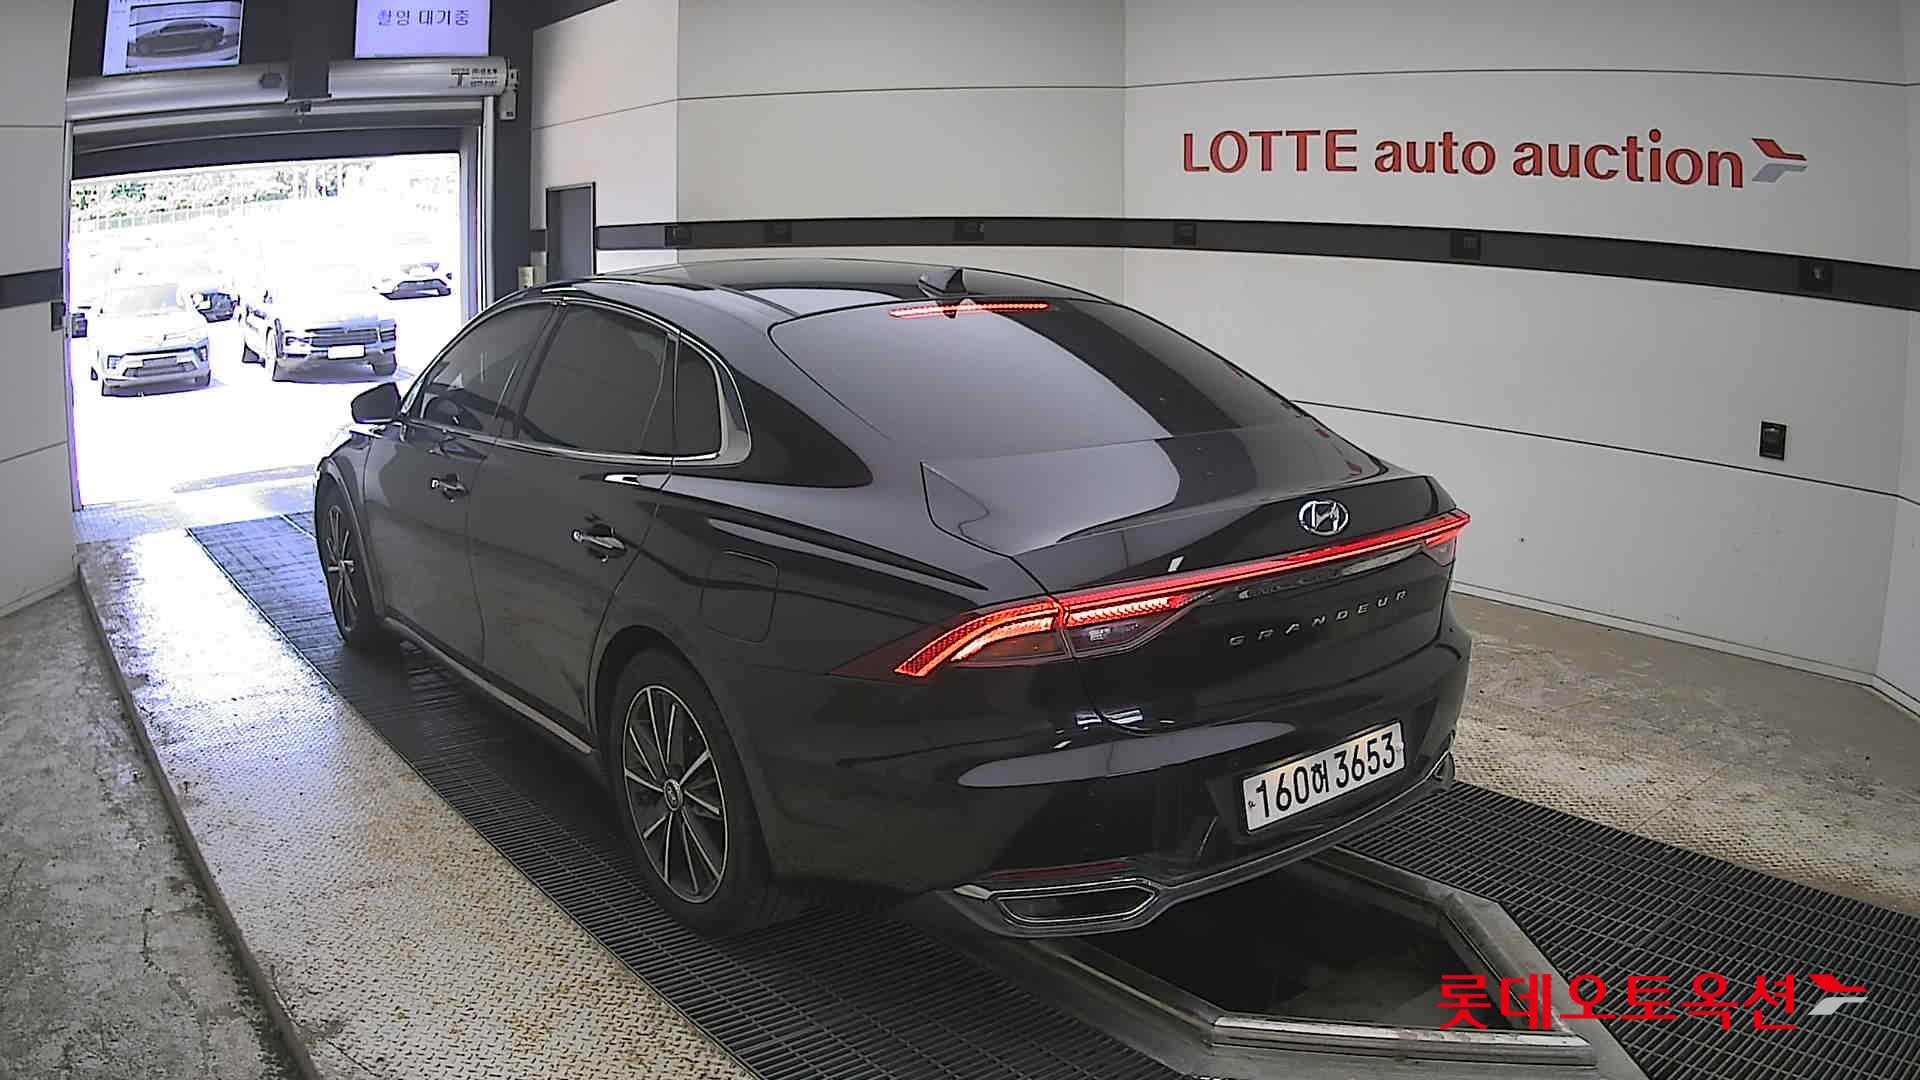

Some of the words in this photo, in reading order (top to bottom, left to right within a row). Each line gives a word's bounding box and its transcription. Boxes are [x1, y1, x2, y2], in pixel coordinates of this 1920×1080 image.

[418, 9, 470, 26] 대기중
[1184, 129, 1358, 173] LOTTE
[1375, 131, 1496, 175] auto
[1513, 129, 1744, 188] auction
[1229, 590, 1408, 646] GRANDEUR
[1256, 760, 1329, 818] 160허
[1333, 731, 1396, 788] 3653
